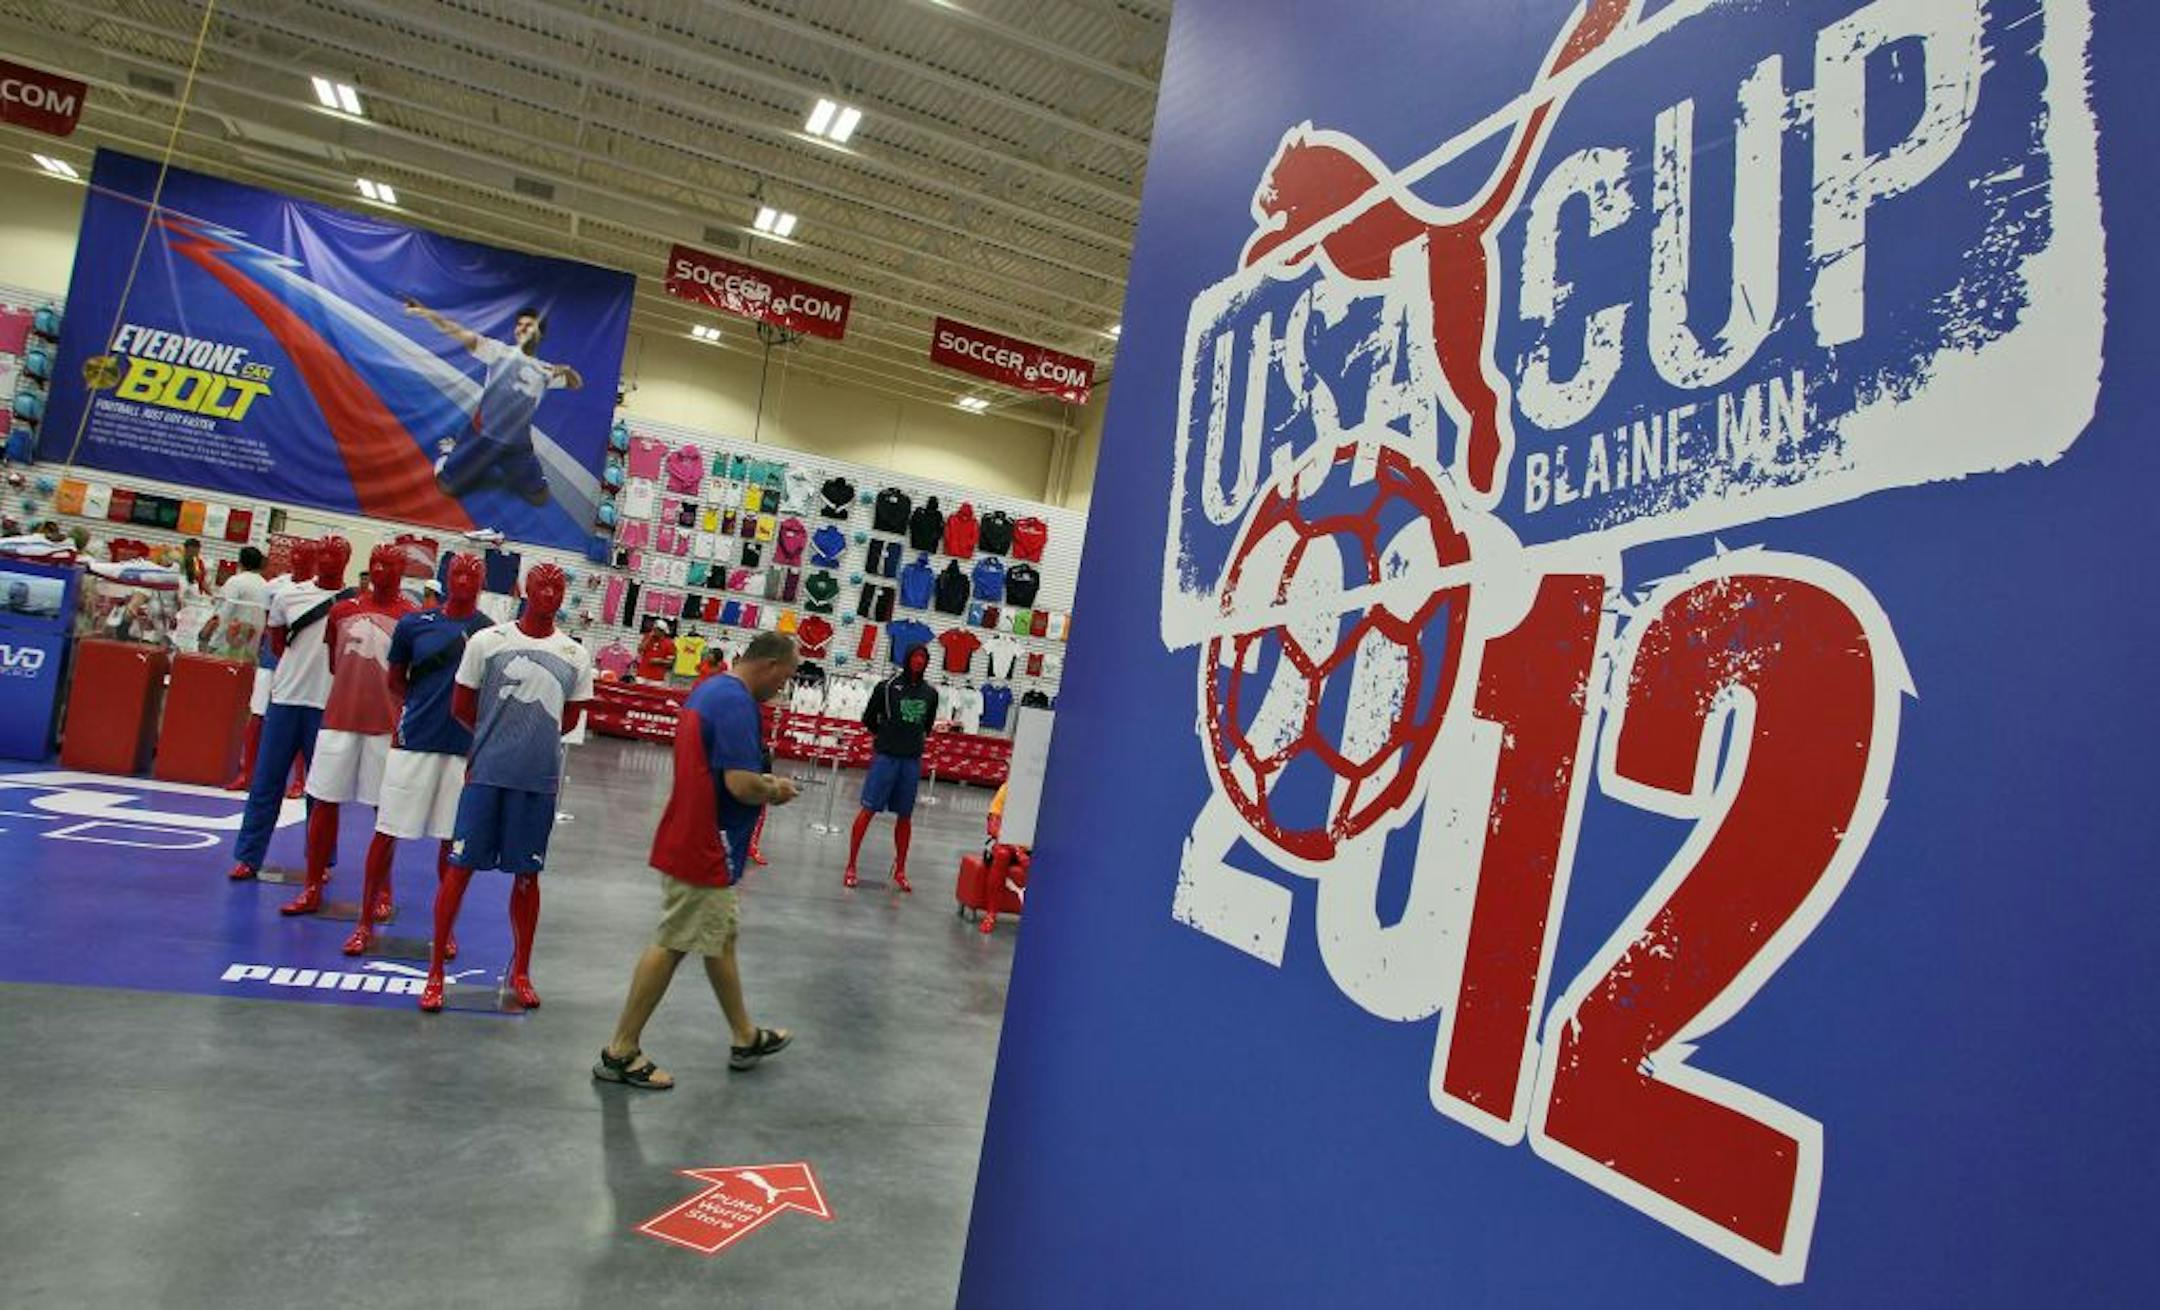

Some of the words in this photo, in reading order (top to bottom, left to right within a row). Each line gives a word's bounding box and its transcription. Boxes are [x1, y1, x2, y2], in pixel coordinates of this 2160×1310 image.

[1202, 225, 1440, 525] USA
[1516, 0, 1998, 430] CUP
[112, 324, 249, 376] EVERYONE
[242, 362, 275, 381] CAN
[115, 356, 272, 422] BOLT
[1524, 402, 1698, 514] BLAINE
[1717, 370, 1807, 476] MN
[1172, 500, 1905, 1285] 2012
[220, 963, 427, 996] PUMA
[683, 1208, 734, 1230] Store
[697, 1200, 755, 1223] World
[709, 1193, 763, 1216] PUMA
